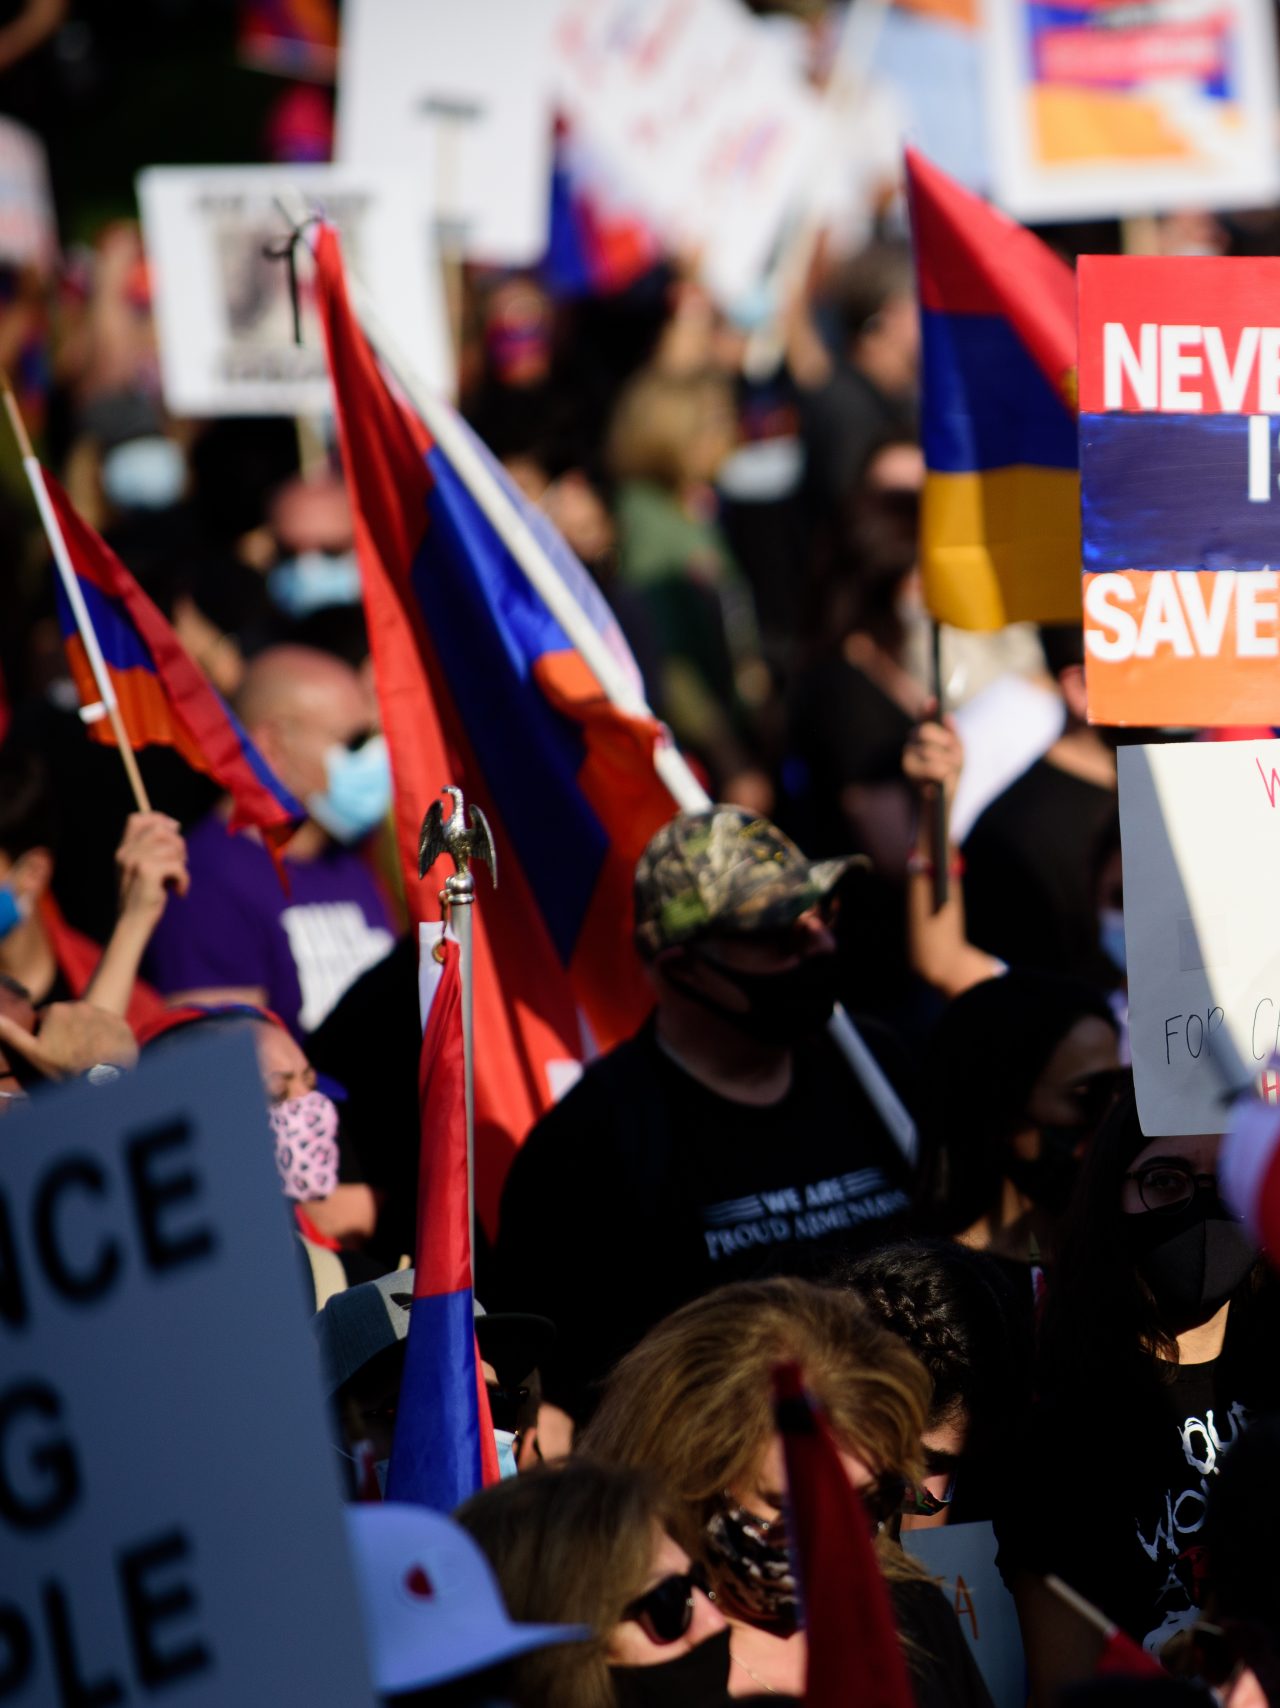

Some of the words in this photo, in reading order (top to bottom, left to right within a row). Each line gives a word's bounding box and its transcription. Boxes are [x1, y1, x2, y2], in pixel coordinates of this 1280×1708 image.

[1085, 568, 1279, 661] SAVE
[0, 1110, 220, 1332] CE
[704, 1217, 791, 1261] PROUD
